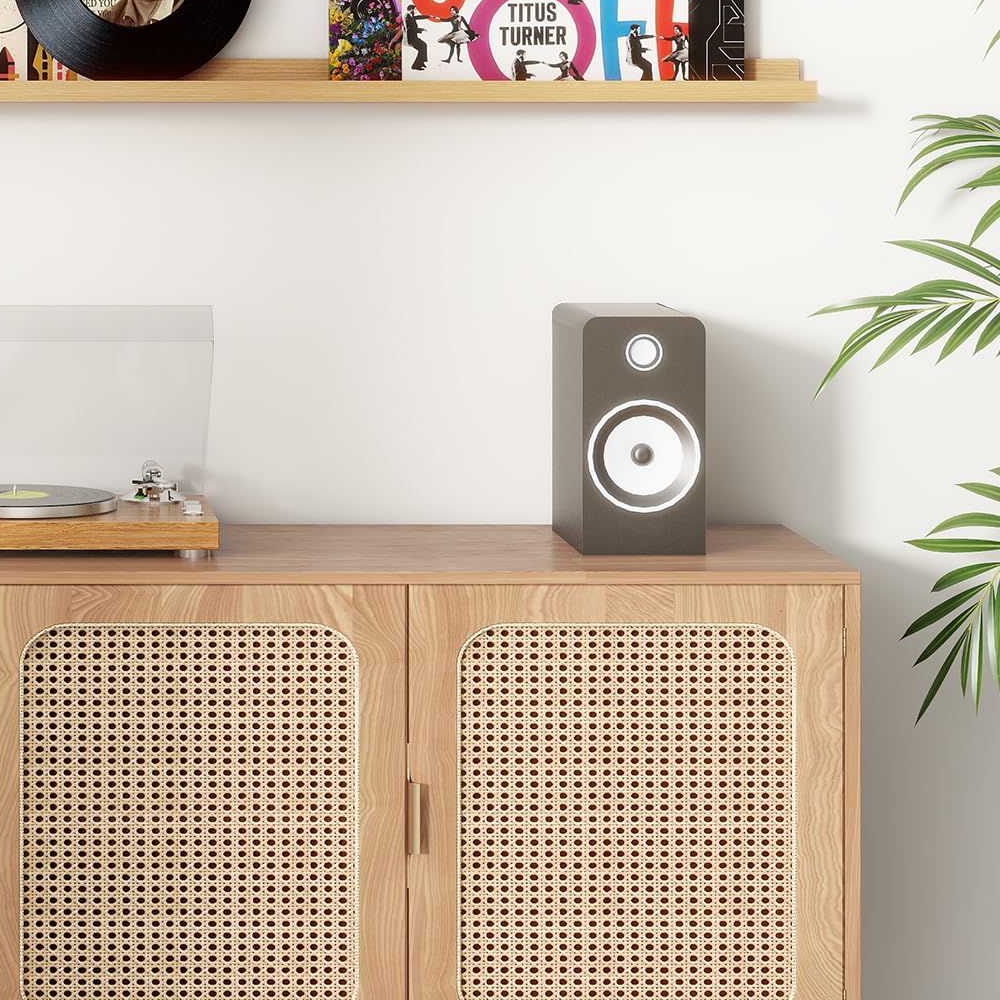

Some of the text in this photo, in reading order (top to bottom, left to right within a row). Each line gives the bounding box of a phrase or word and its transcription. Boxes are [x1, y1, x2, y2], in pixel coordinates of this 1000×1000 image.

[99, 0, 116, 7] YOU
[507, 2, 557, 22] TITUS
[500, 26, 567, 46] TURNER
